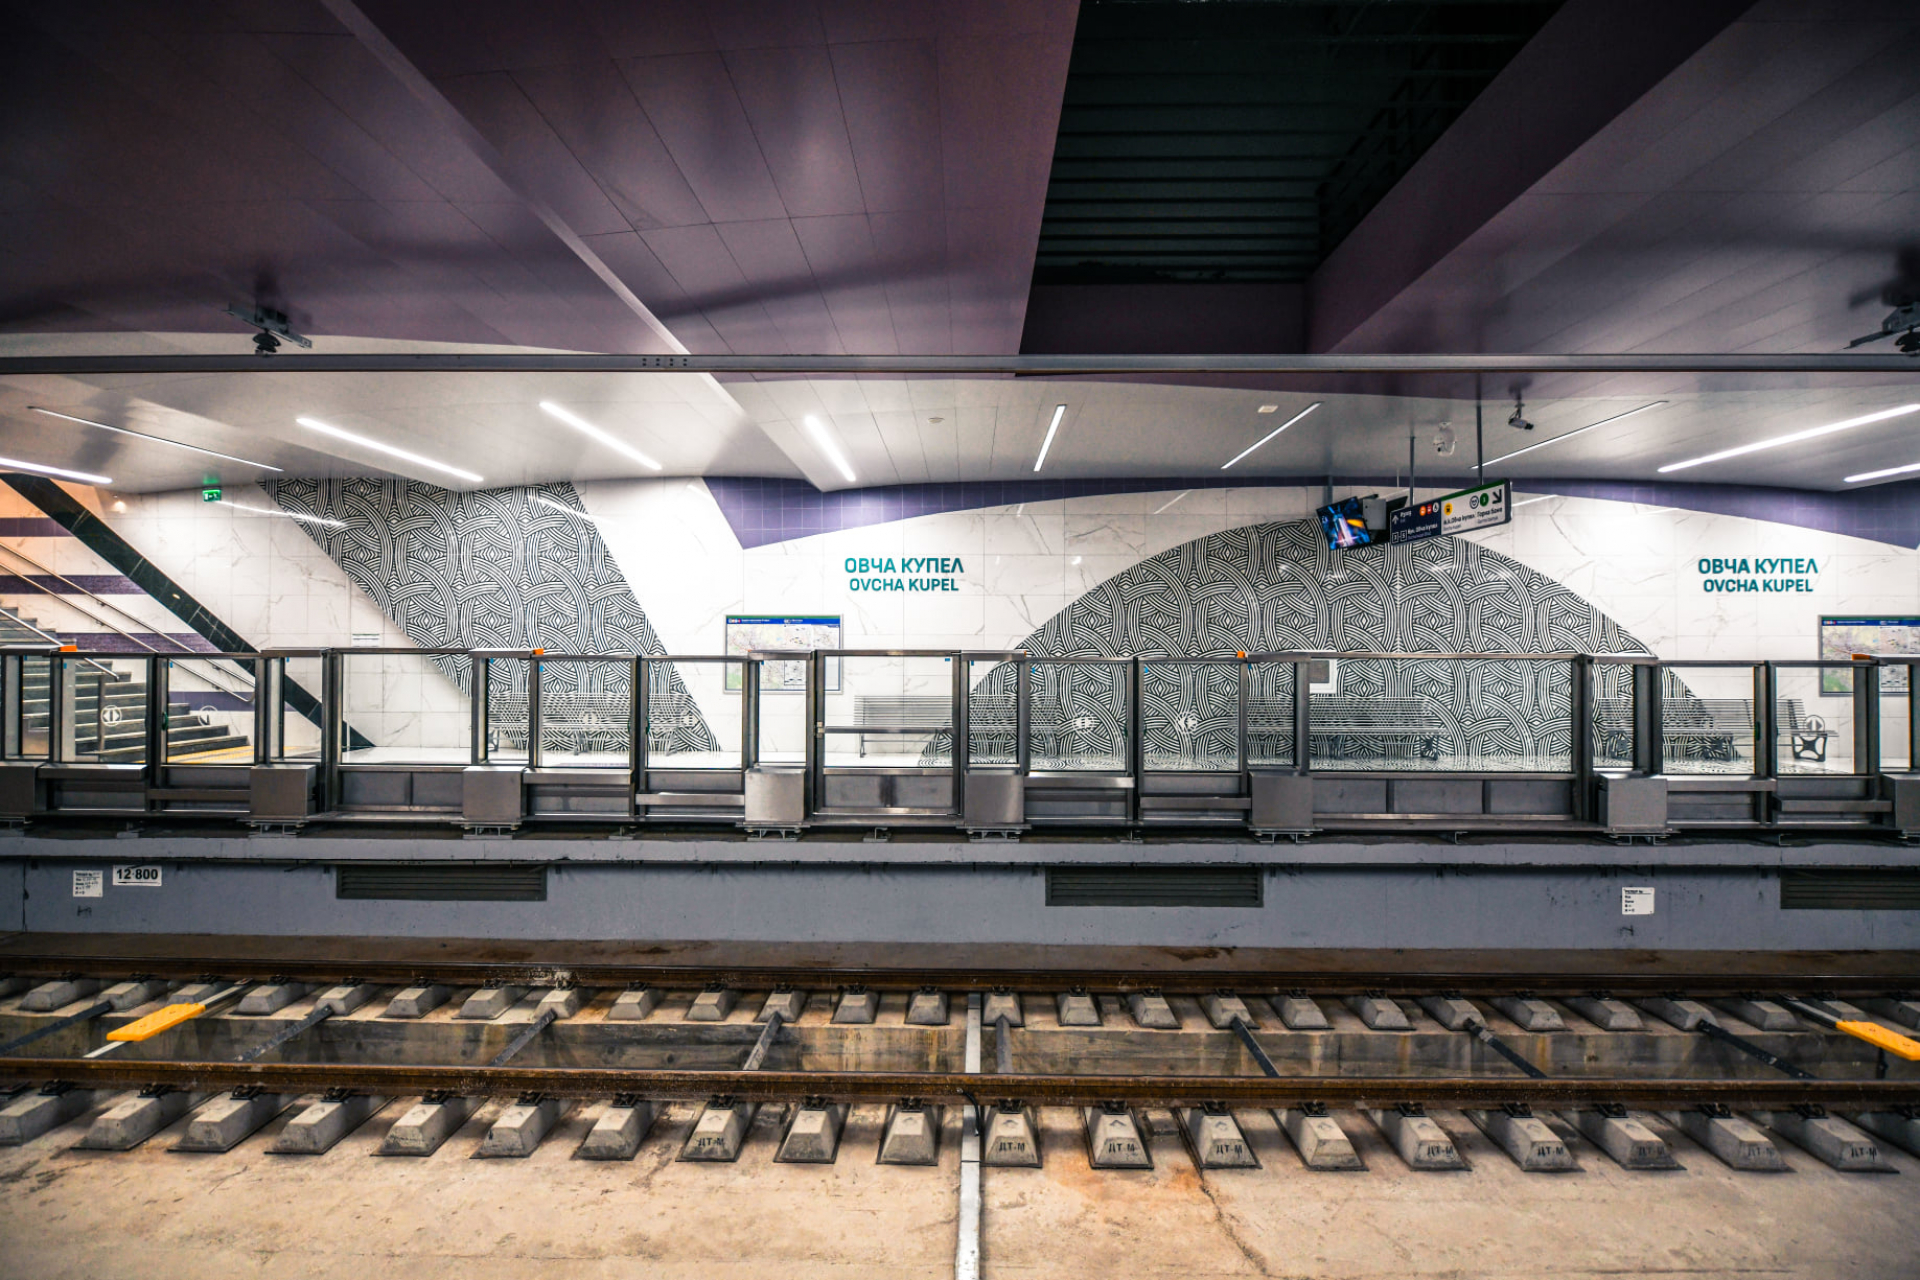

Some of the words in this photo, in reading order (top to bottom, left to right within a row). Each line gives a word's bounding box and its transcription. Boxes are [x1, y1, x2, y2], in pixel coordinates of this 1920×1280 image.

[844, 557, 896, 574] ОВЧА
[901, 557, 965, 574] КУПЕЛ
[1698, 558, 1751, 575] ОВЧА
[1755, 558, 1819, 574] КУПЕЛ
[849, 578, 905, 591] OVCHA
[908, 578, 959, 591] KUPEL
[1703, 578, 1759, 592] OVCHA
[1763, 578, 1814, 592] KUPEL
